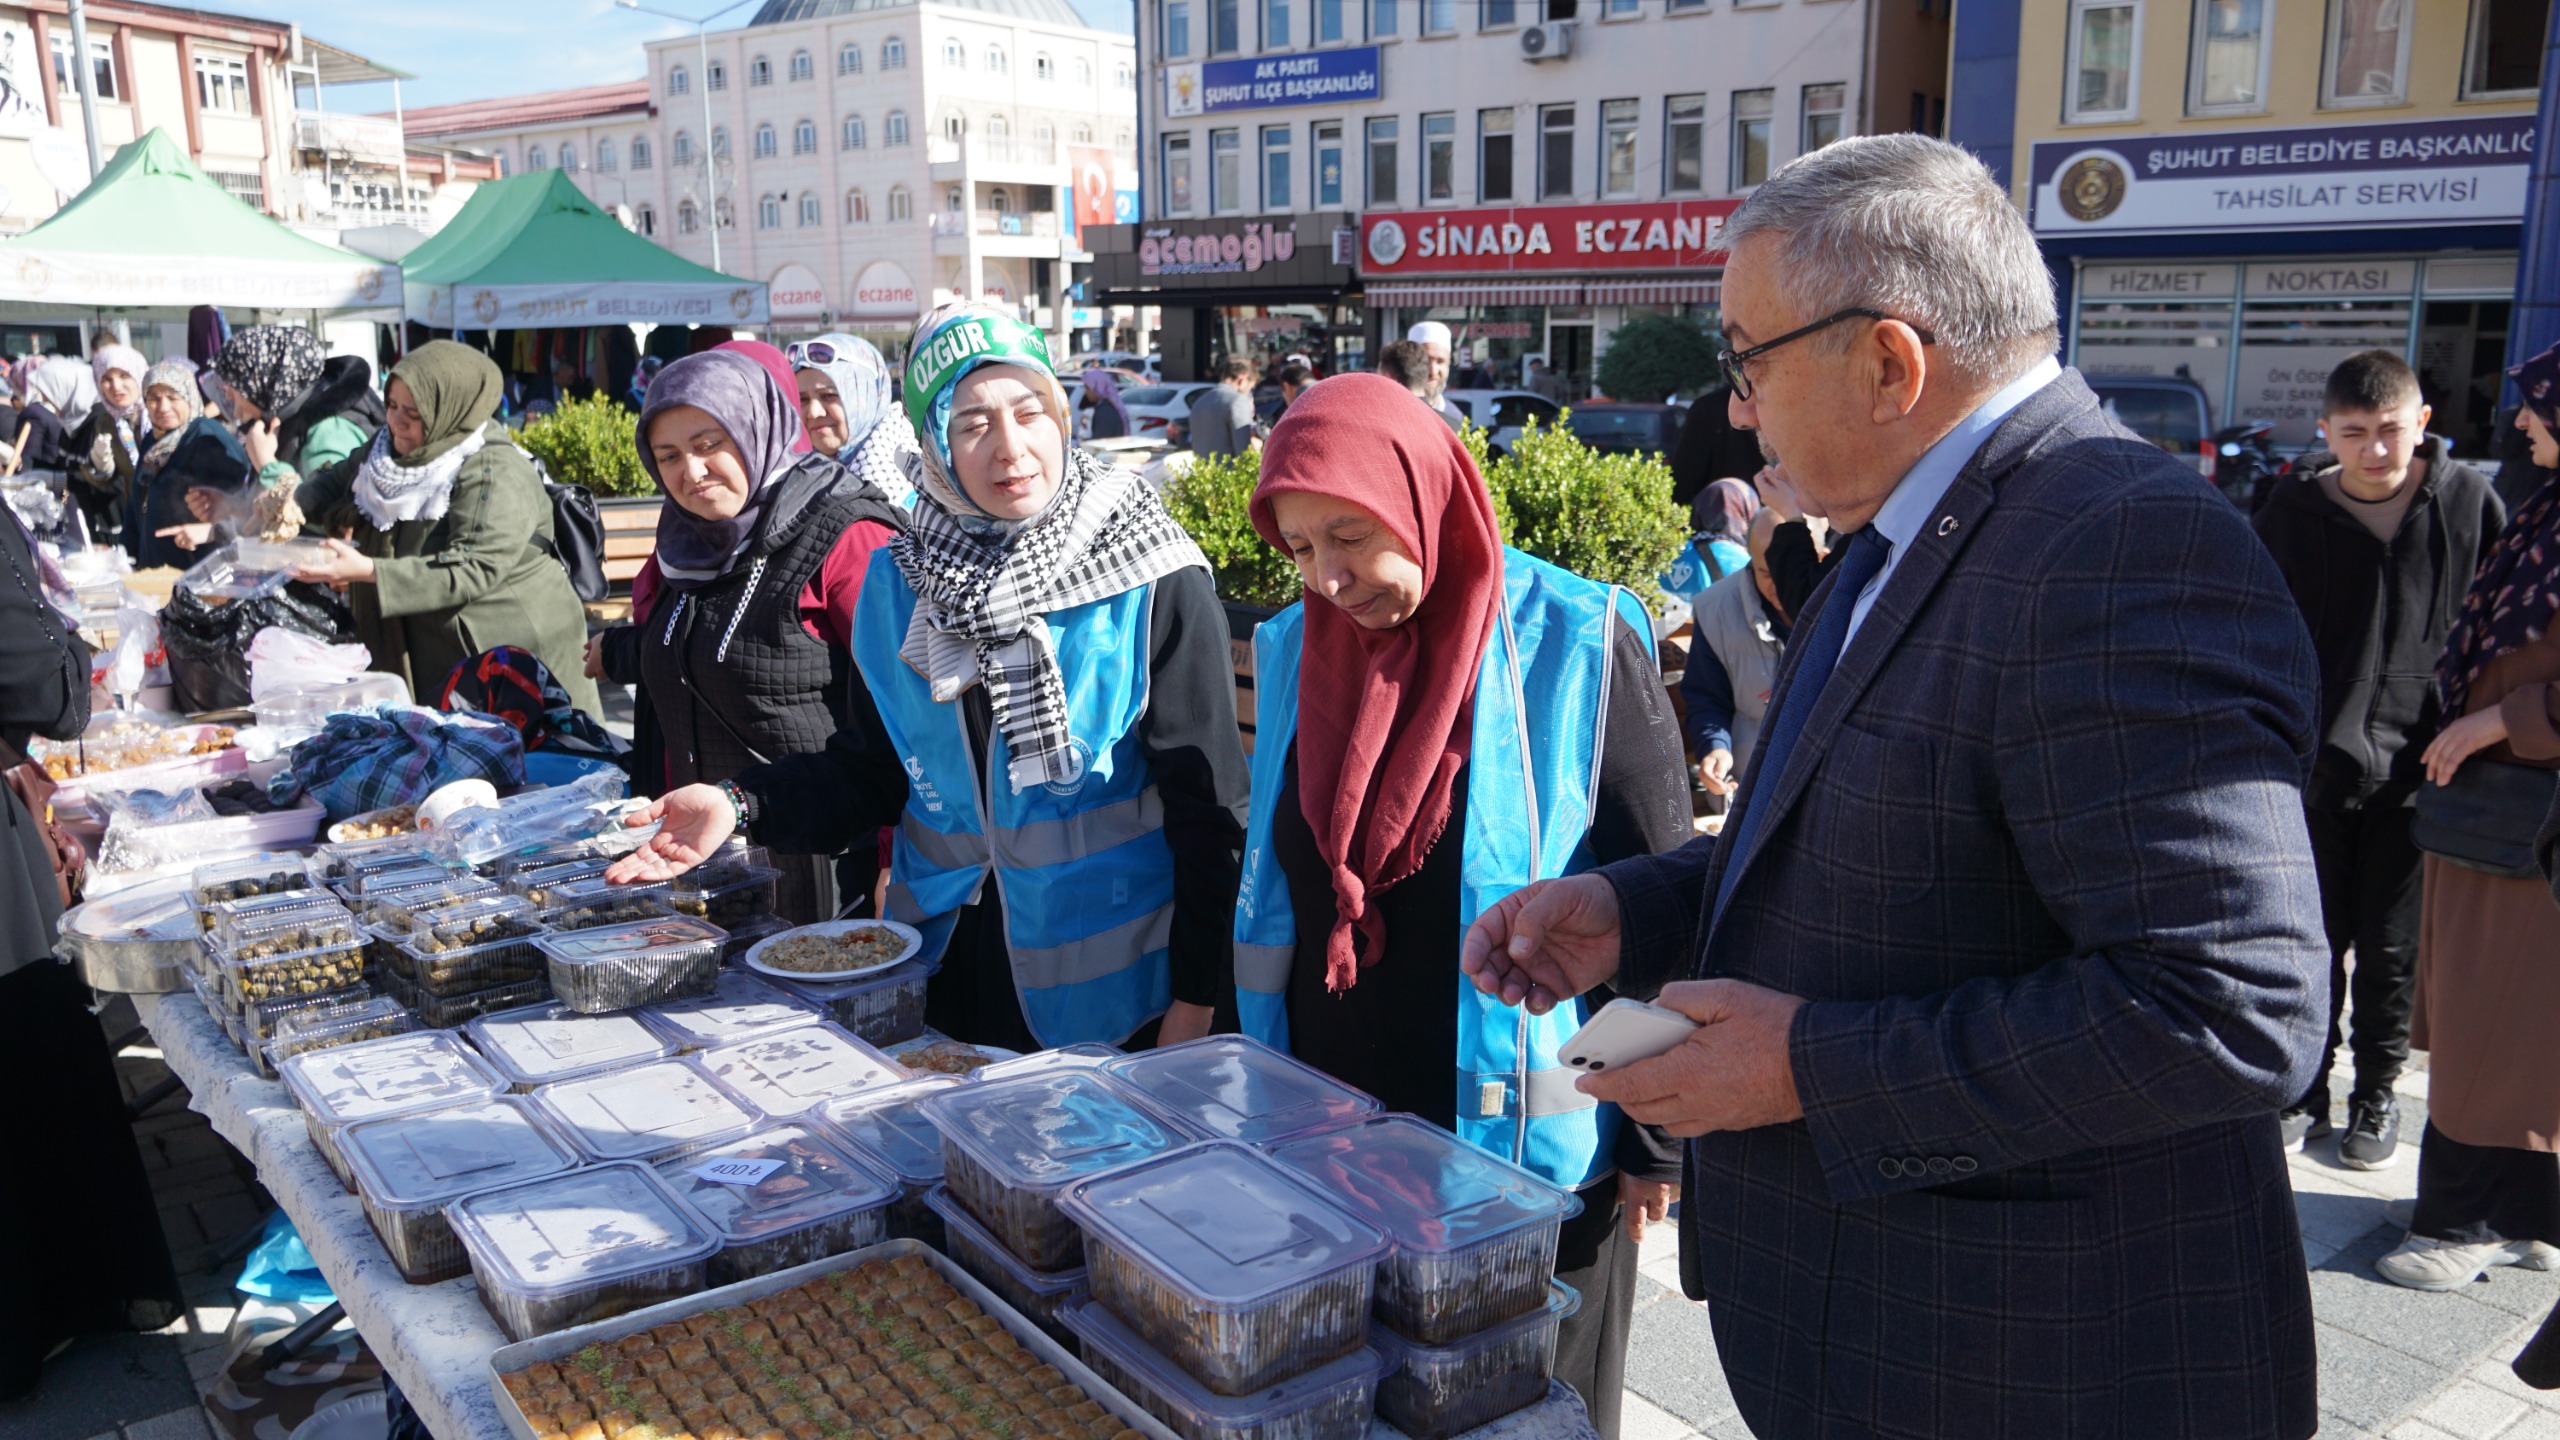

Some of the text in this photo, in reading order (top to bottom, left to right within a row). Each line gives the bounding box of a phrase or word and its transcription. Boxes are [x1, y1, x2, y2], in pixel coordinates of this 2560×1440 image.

[1255, 58, 1319, 79] AK PARTİ
[1205, 70, 1375, 108] ŞUHUT İLÇE BAŞKANLIĞI
[2147, 127, 2535, 174] ŞUHUT BELEDİYE BAŞKANLIĞ
[2213, 177, 2480, 210] TAHSİLAT SERVİSİ
[1417, 215, 1724, 258] SİNADA ECZANE
[772, 287, 822, 305] eczane
[859, 286, 914, 303] eczane
[2109, 269, 2389, 293] HİZMET NOKTASI
[913, 321, 992, 394] ÖZGÜR
